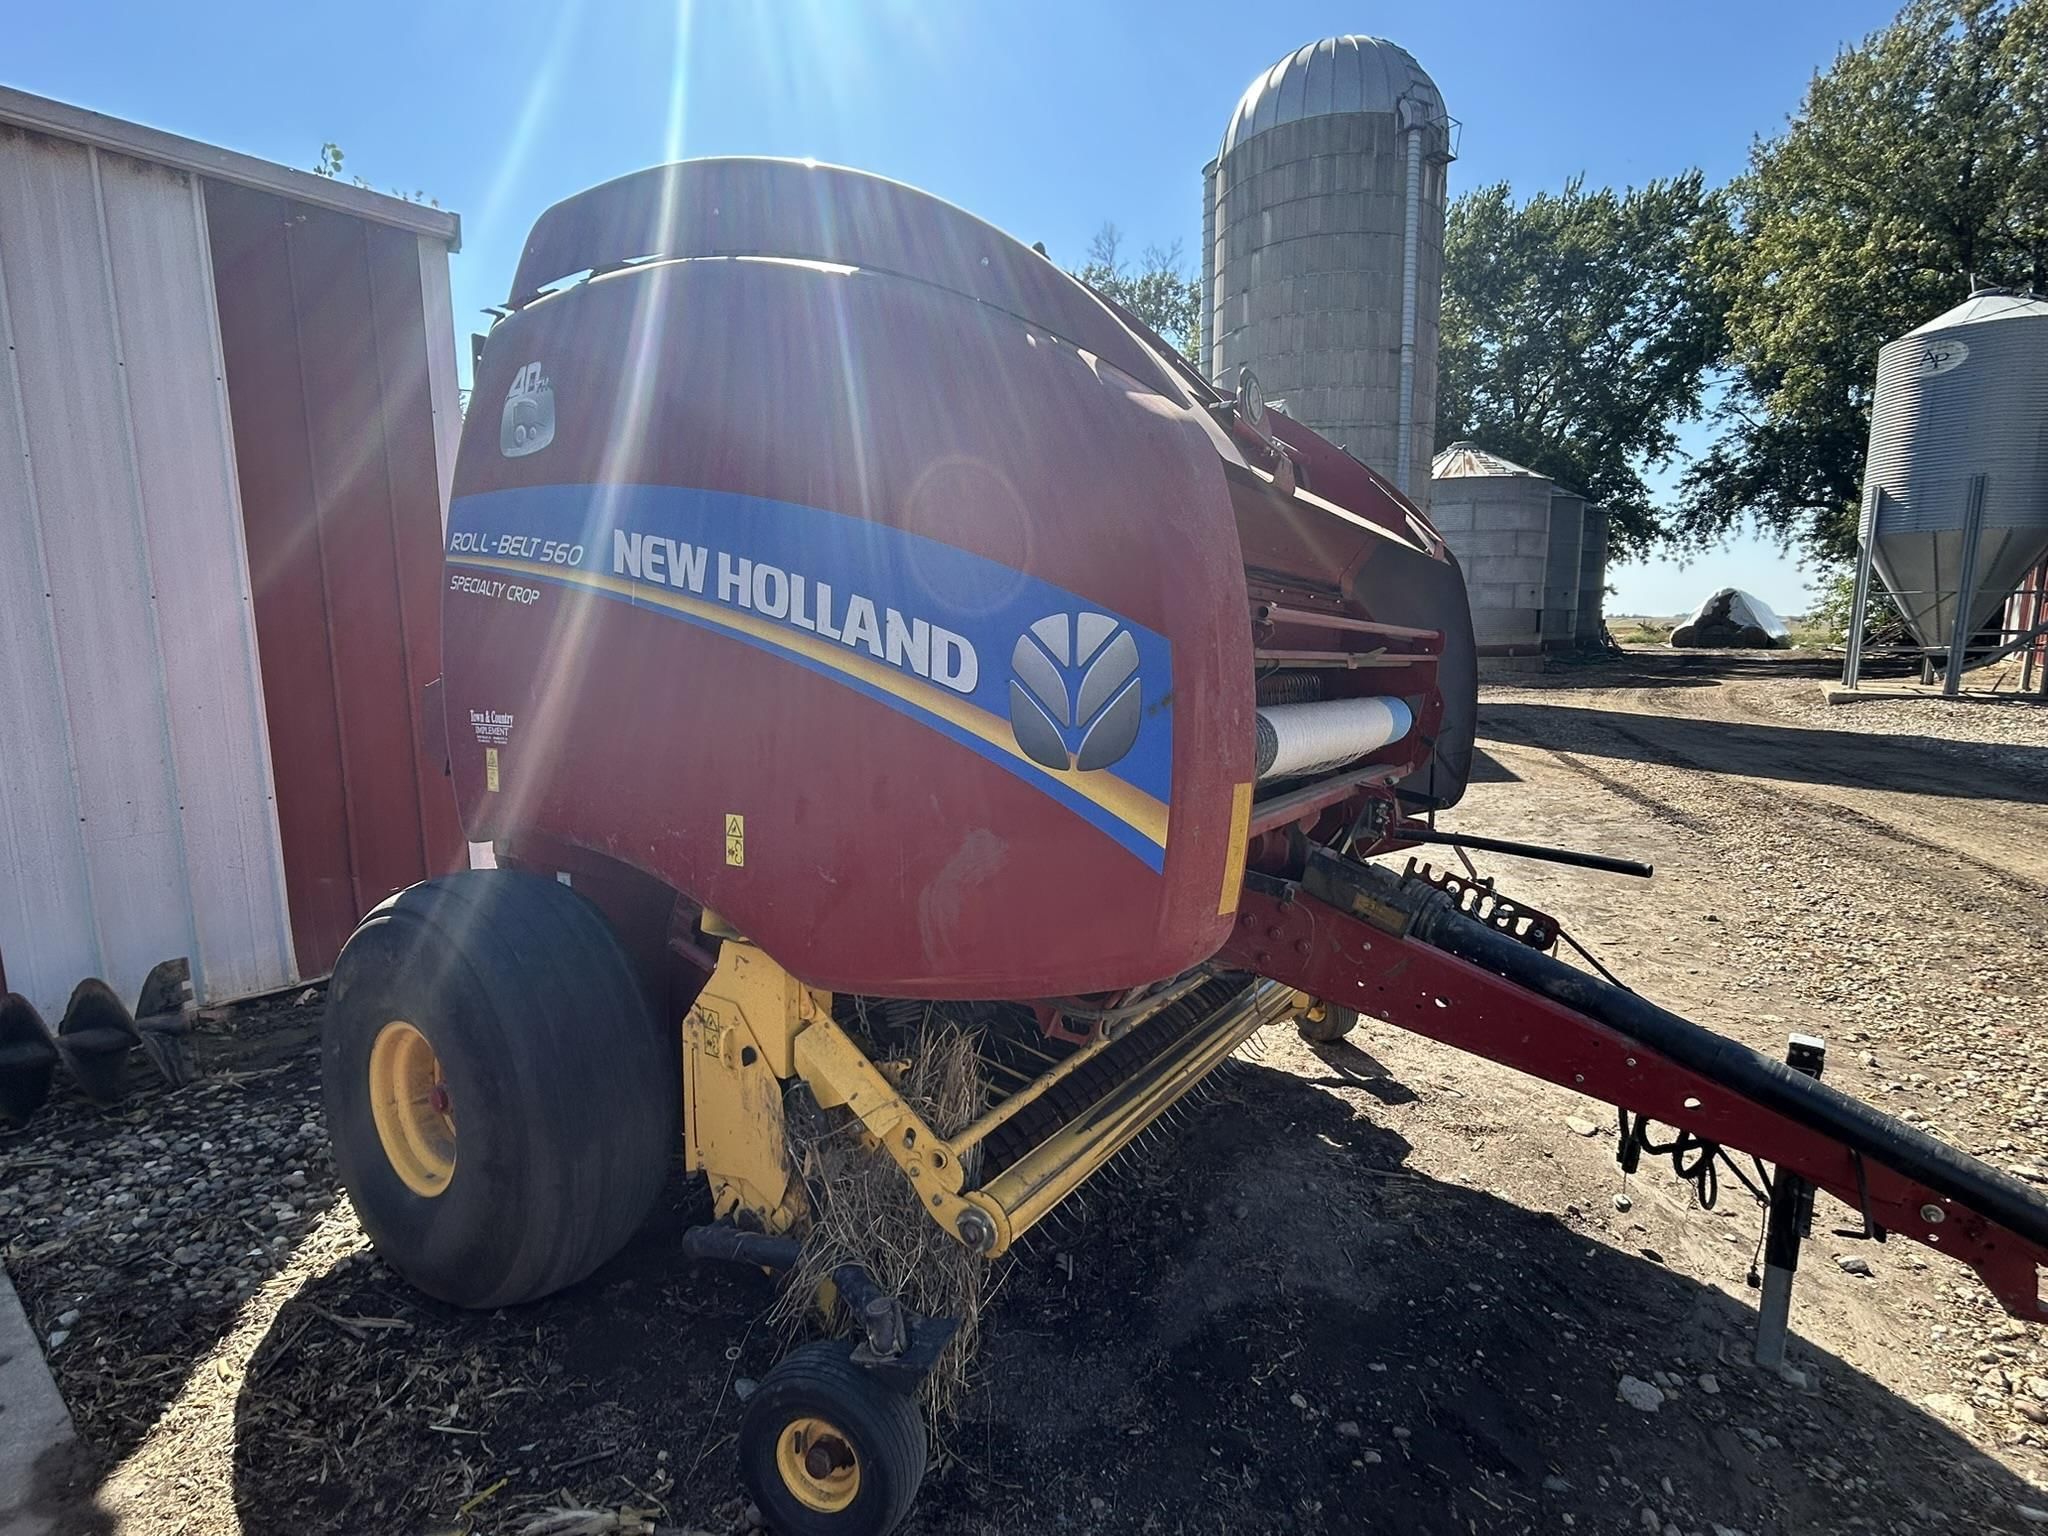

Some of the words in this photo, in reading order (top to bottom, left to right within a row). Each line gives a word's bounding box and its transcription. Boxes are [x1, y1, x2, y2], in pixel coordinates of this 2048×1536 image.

[540, 541, 584, 567] 560
[450, 575, 506, 598] SPECIALTY
[506, 585, 541, 606] CROP
[613, 528, 708, 594] NEW
[717, 551, 979, 694] HOLLAND
[470, 709, 485, 723] Town
[491, 710, 513, 726] Country
[475, 726, 509, 736] IMPLEMENT
